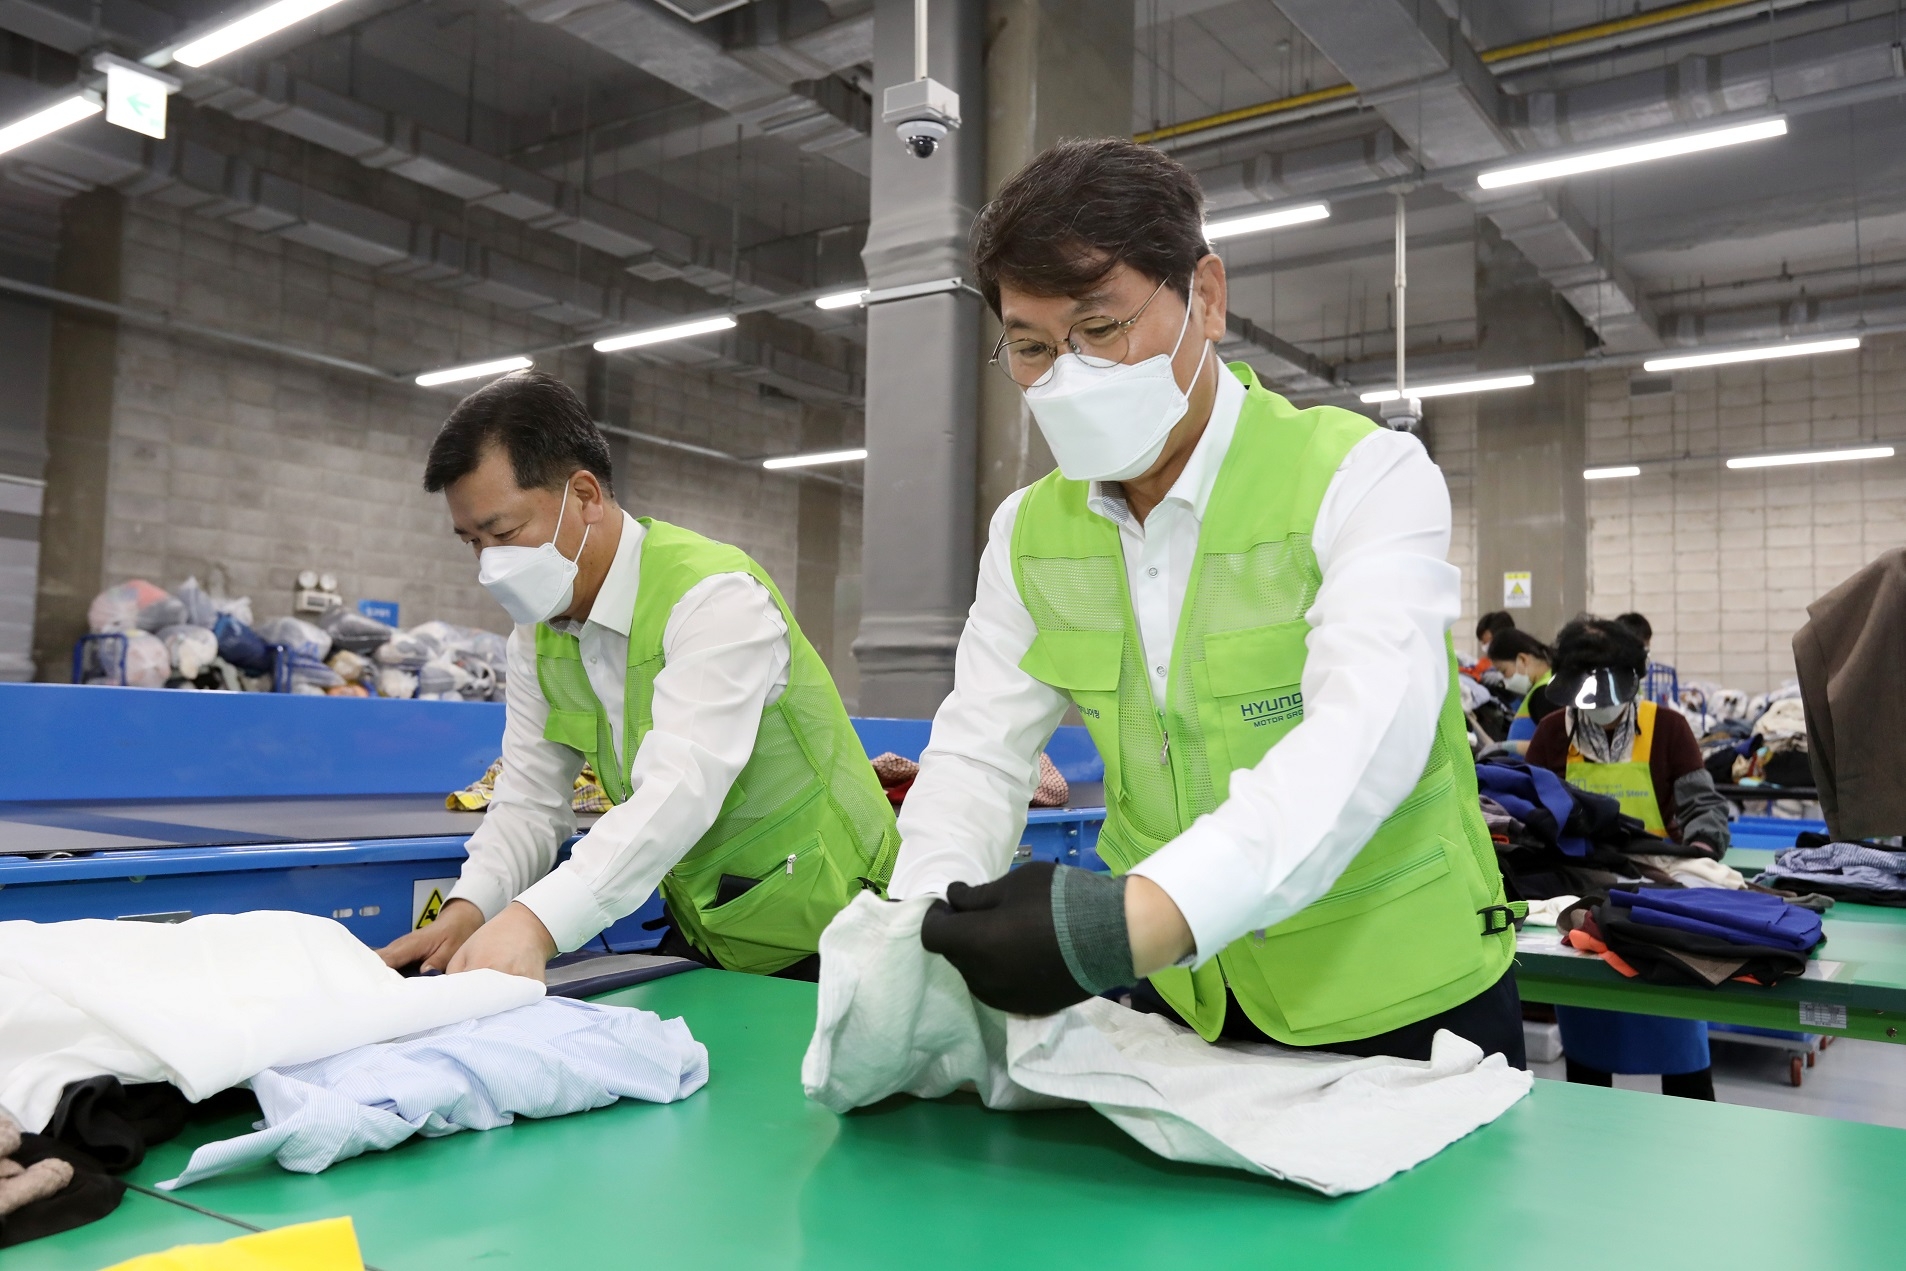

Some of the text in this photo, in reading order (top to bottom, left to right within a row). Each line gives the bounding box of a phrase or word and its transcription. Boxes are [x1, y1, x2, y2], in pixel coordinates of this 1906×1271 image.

[1241, 692, 1303, 716] HYUND
[1254, 709, 1303, 727] MOTOR GRO
[1626, 790, 1649, 798] Store
